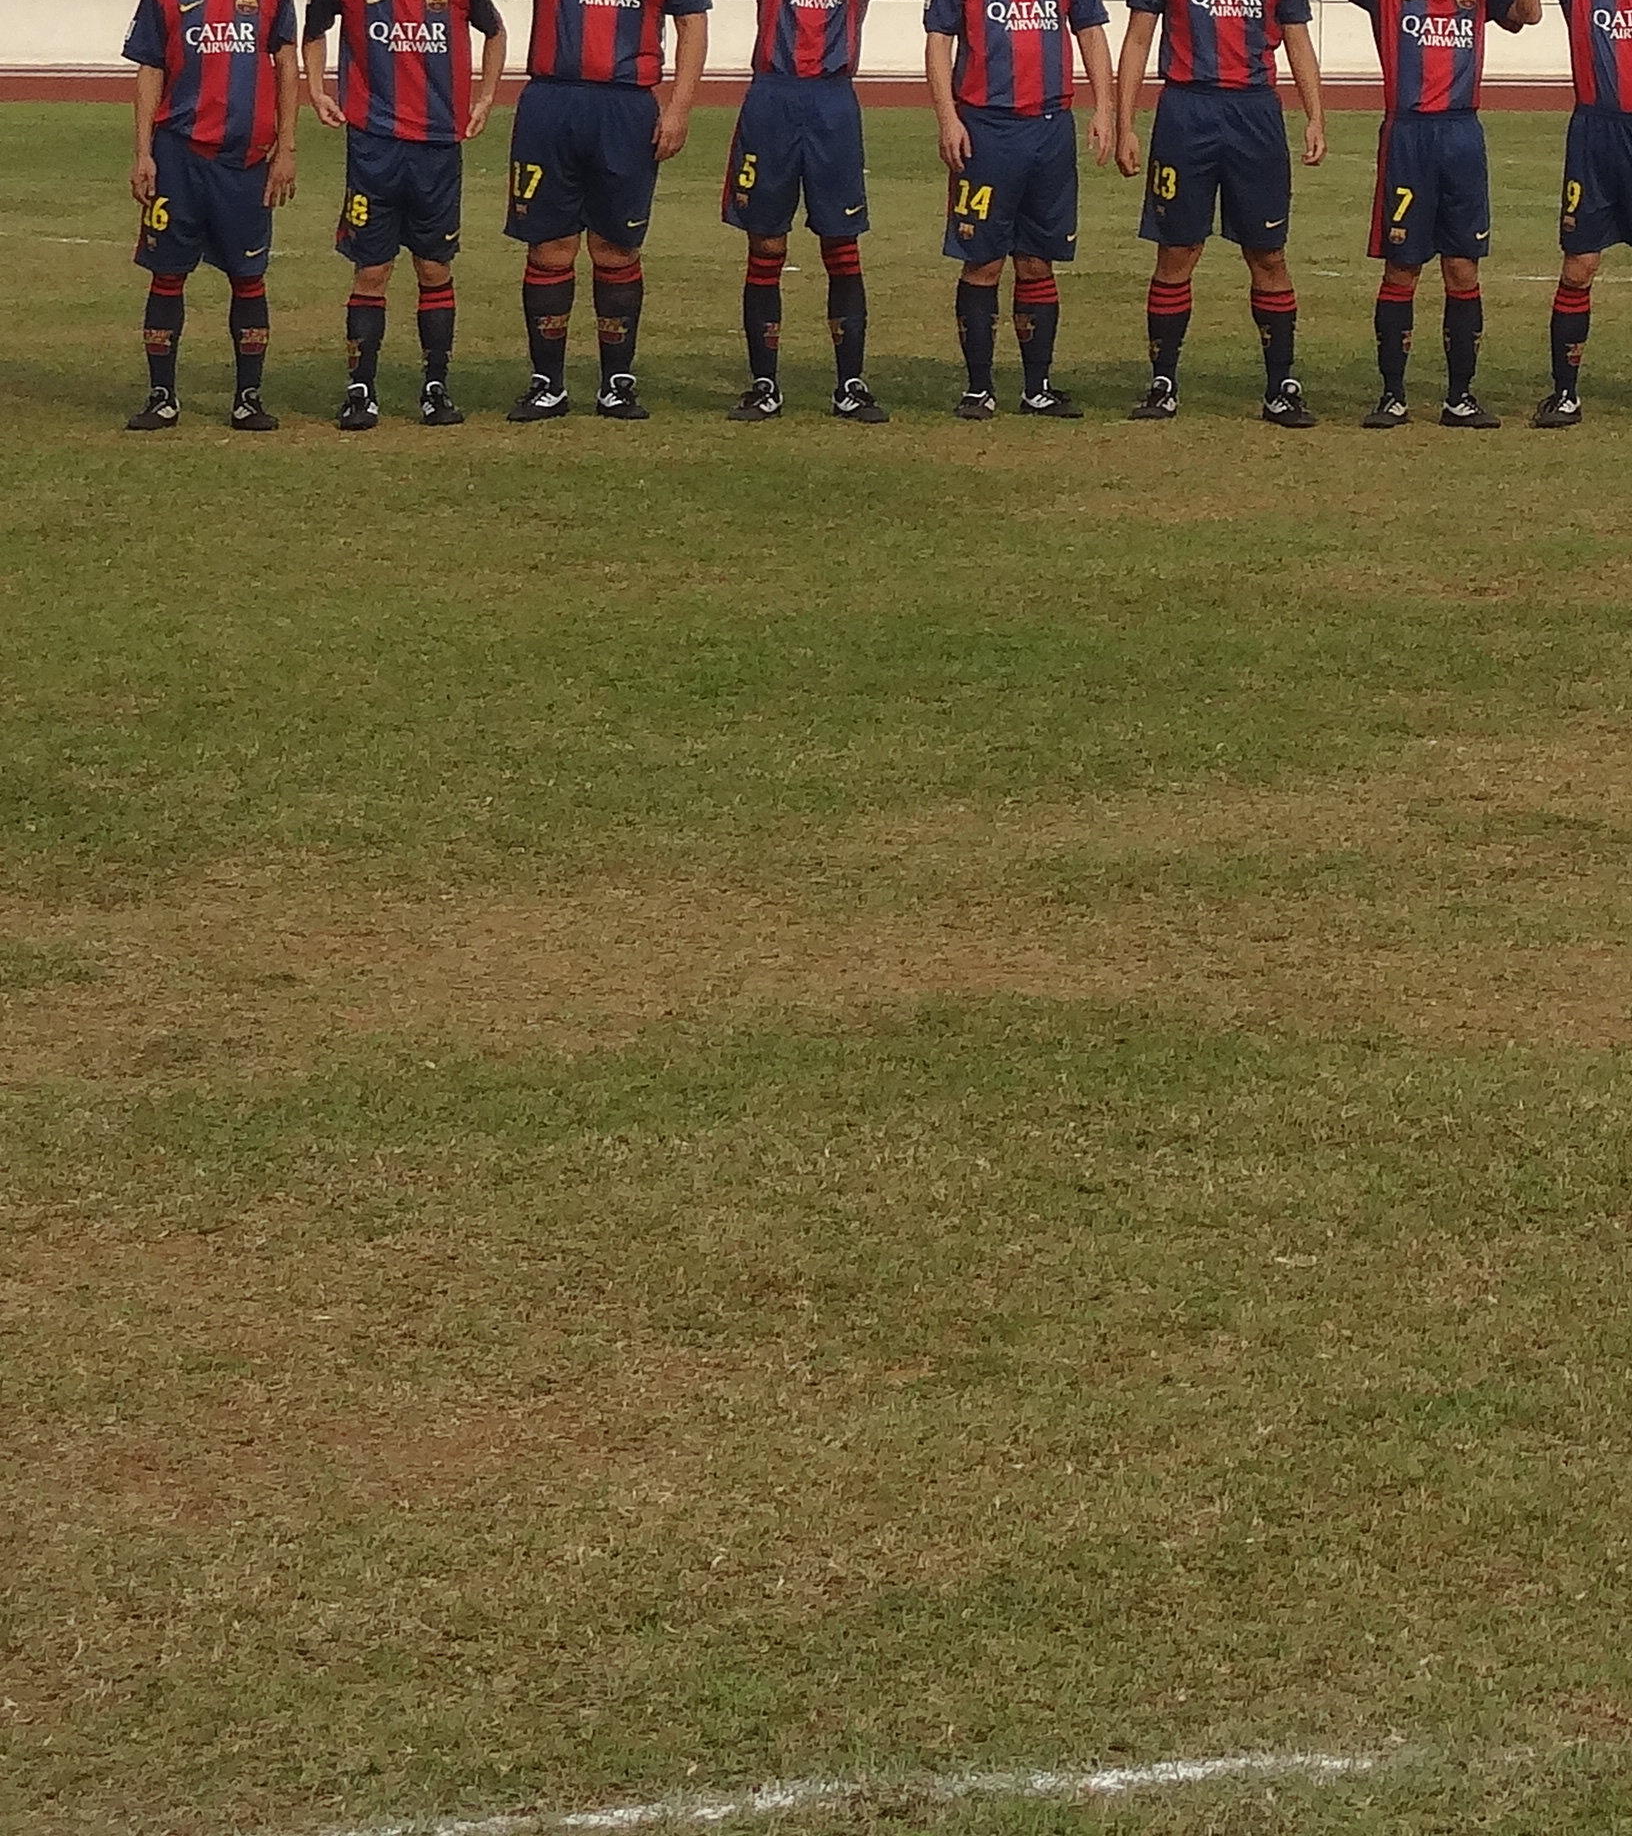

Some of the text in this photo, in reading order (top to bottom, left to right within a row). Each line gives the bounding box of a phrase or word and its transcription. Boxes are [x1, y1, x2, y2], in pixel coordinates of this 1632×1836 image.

[987, 0, 1057, 23] QATAR
[1209, 5, 1262, 18] AIRWAYS
[369, 22, 447, 44] QATAR
[1005, 19, 1058, 31] AIRWAYS
[1402, 15, 1474, 37] QATAR
[197, 41, 255, 54] AIRWAYS
[388, 41, 447, 53] AIRWAYS
[1418, 35, 1473, 48] AIRWAYS
[514, 161, 543, 199] 17
[739, 154, 757, 188] 5
[1153, 160, 1176, 200] 13
[955, 179, 993, 220] 14
[1393, 187, 1413, 221] 7
[1567, 180, 1581, 213] 9
